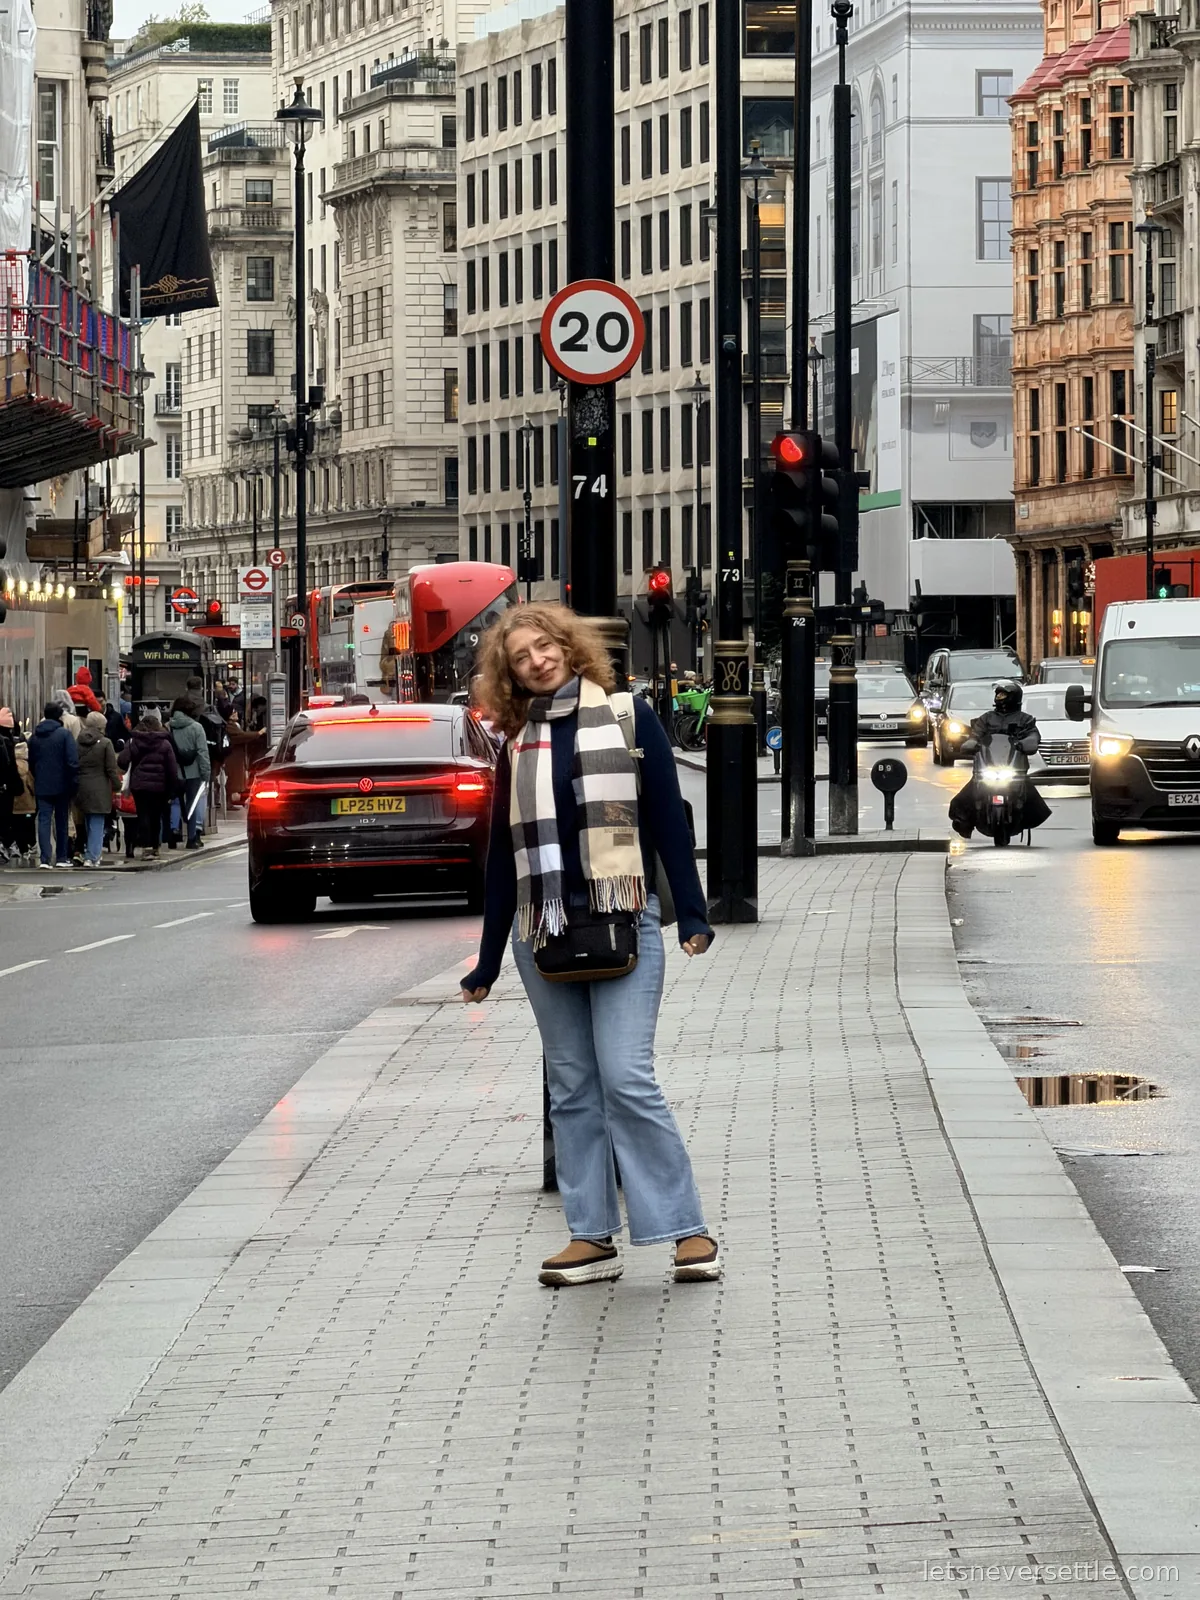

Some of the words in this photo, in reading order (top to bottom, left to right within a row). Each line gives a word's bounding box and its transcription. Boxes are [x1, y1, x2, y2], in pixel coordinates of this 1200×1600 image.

[177, 290, 208, 301] ARCADE
[558, 311, 630, 353] 20
[572, 474, 609, 500] 74
[270, 551, 282, 565] G
[721, 568, 740, 582] 73
[292, 618, 304, 627] 20
[792, 617, 806, 626] 72
[163, 651, 180, 659] here
[340, 799, 374, 812] LP25
[377, 798, 403, 810] HVZ
[1174, 794, 1199, 804] EX24
